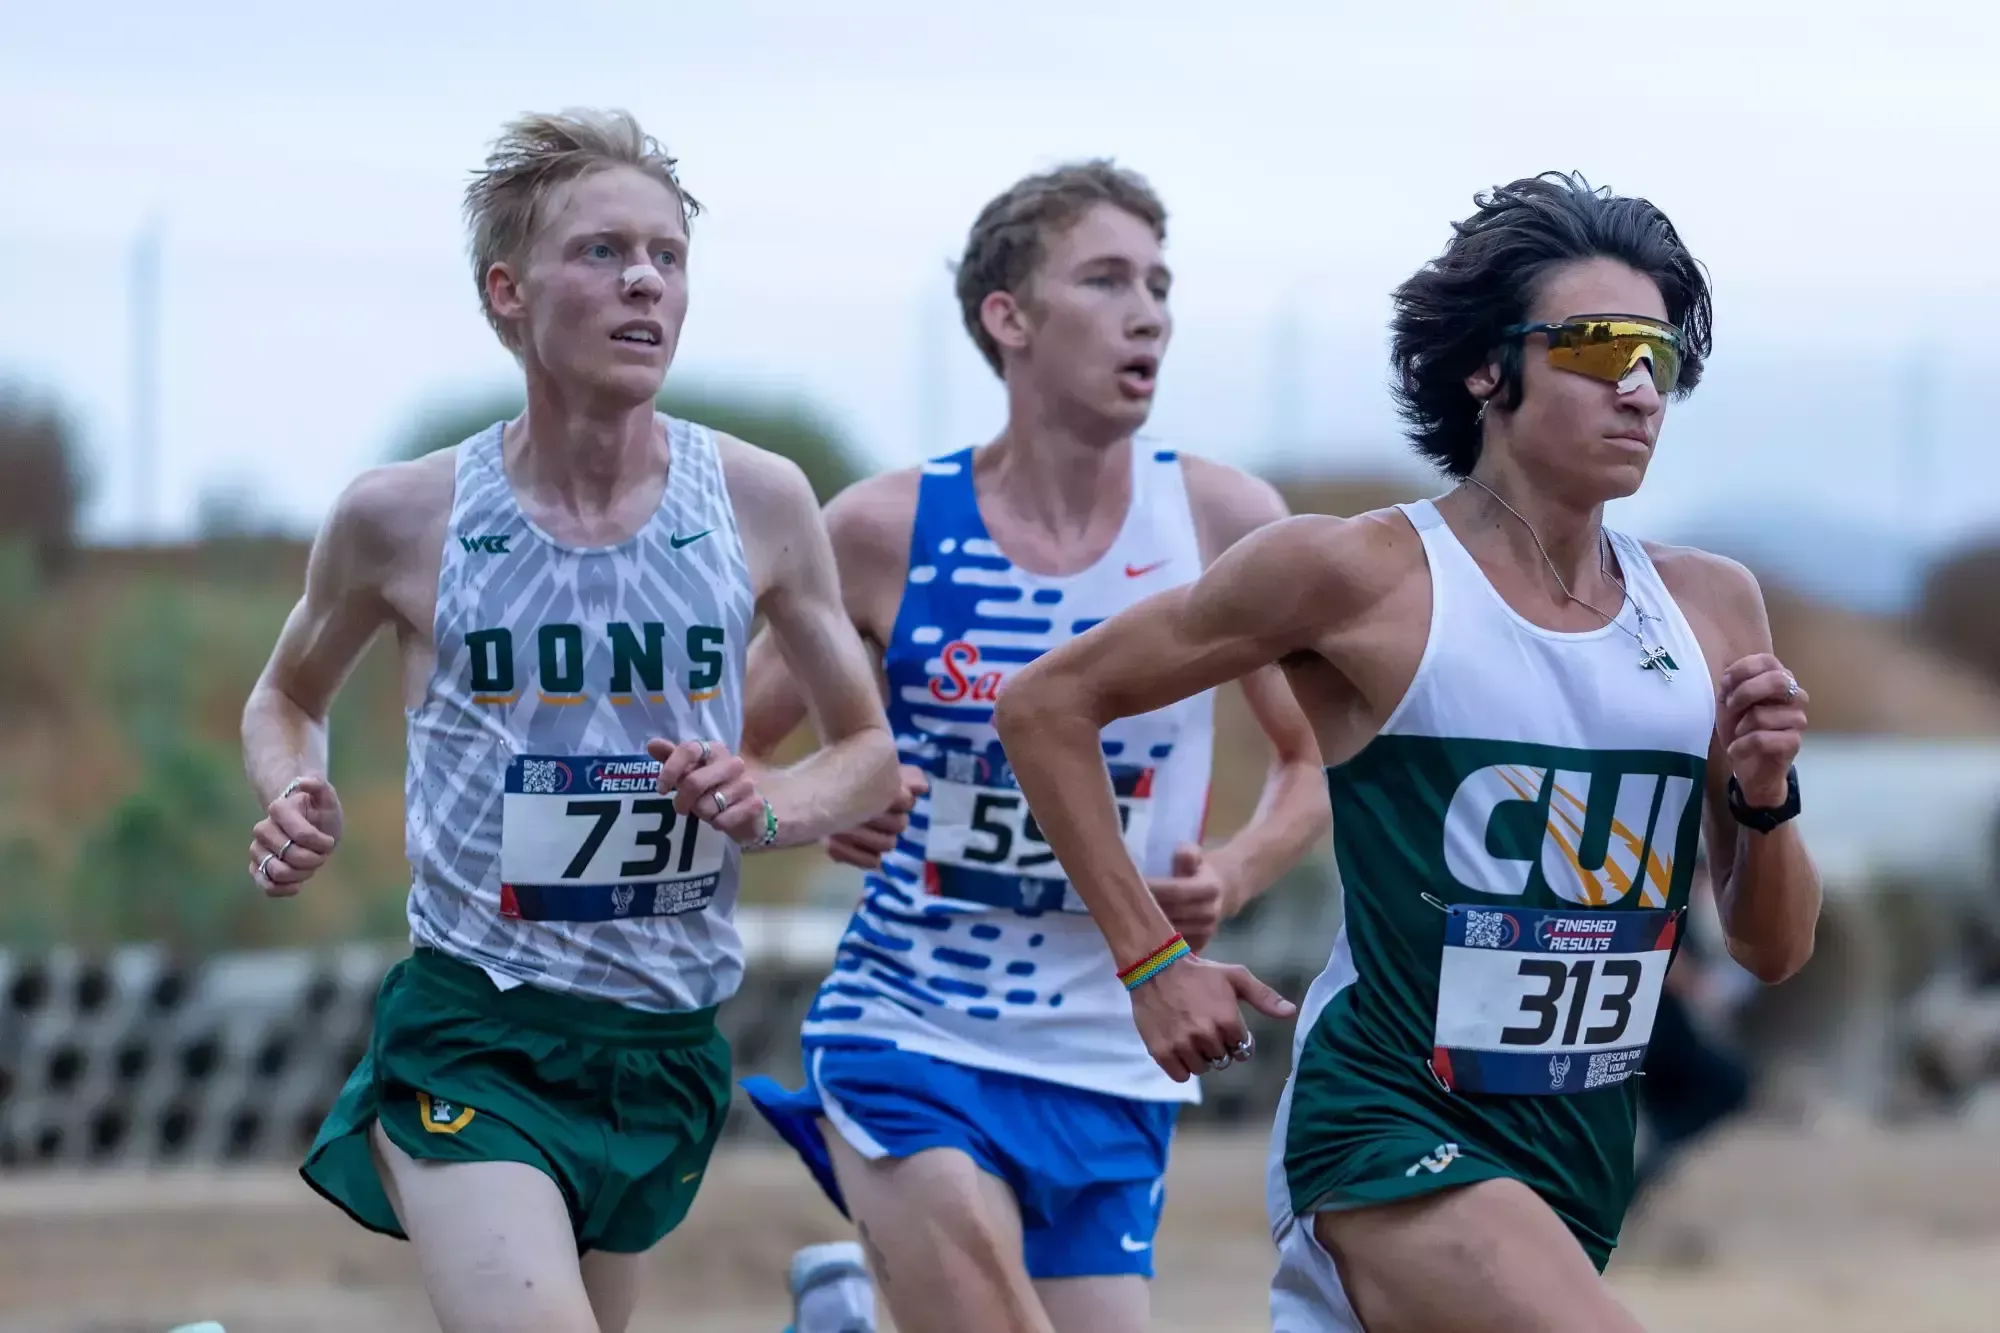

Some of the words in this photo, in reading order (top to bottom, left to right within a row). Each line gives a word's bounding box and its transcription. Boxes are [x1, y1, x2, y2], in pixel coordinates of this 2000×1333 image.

[459, 535, 511, 553] WCC
[464, 622, 724, 693] DONS
[604, 761, 665, 775] FINISHE
[601, 778, 659, 792] RESULT
[561, 798, 700, 879] 731
[1443, 764, 1694, 909] CUI
[1554, 919, 1617, 932] FINISHED
[1549, 936, 1612, 951] RESULTS
[1501, 959, 1642, 1045] 313
[1611, 1051, 1628, 1062] SCAN
[1628, 1049, 1641, 1060] FOR
[1609, 1062, 1626, 1073] YOUR
